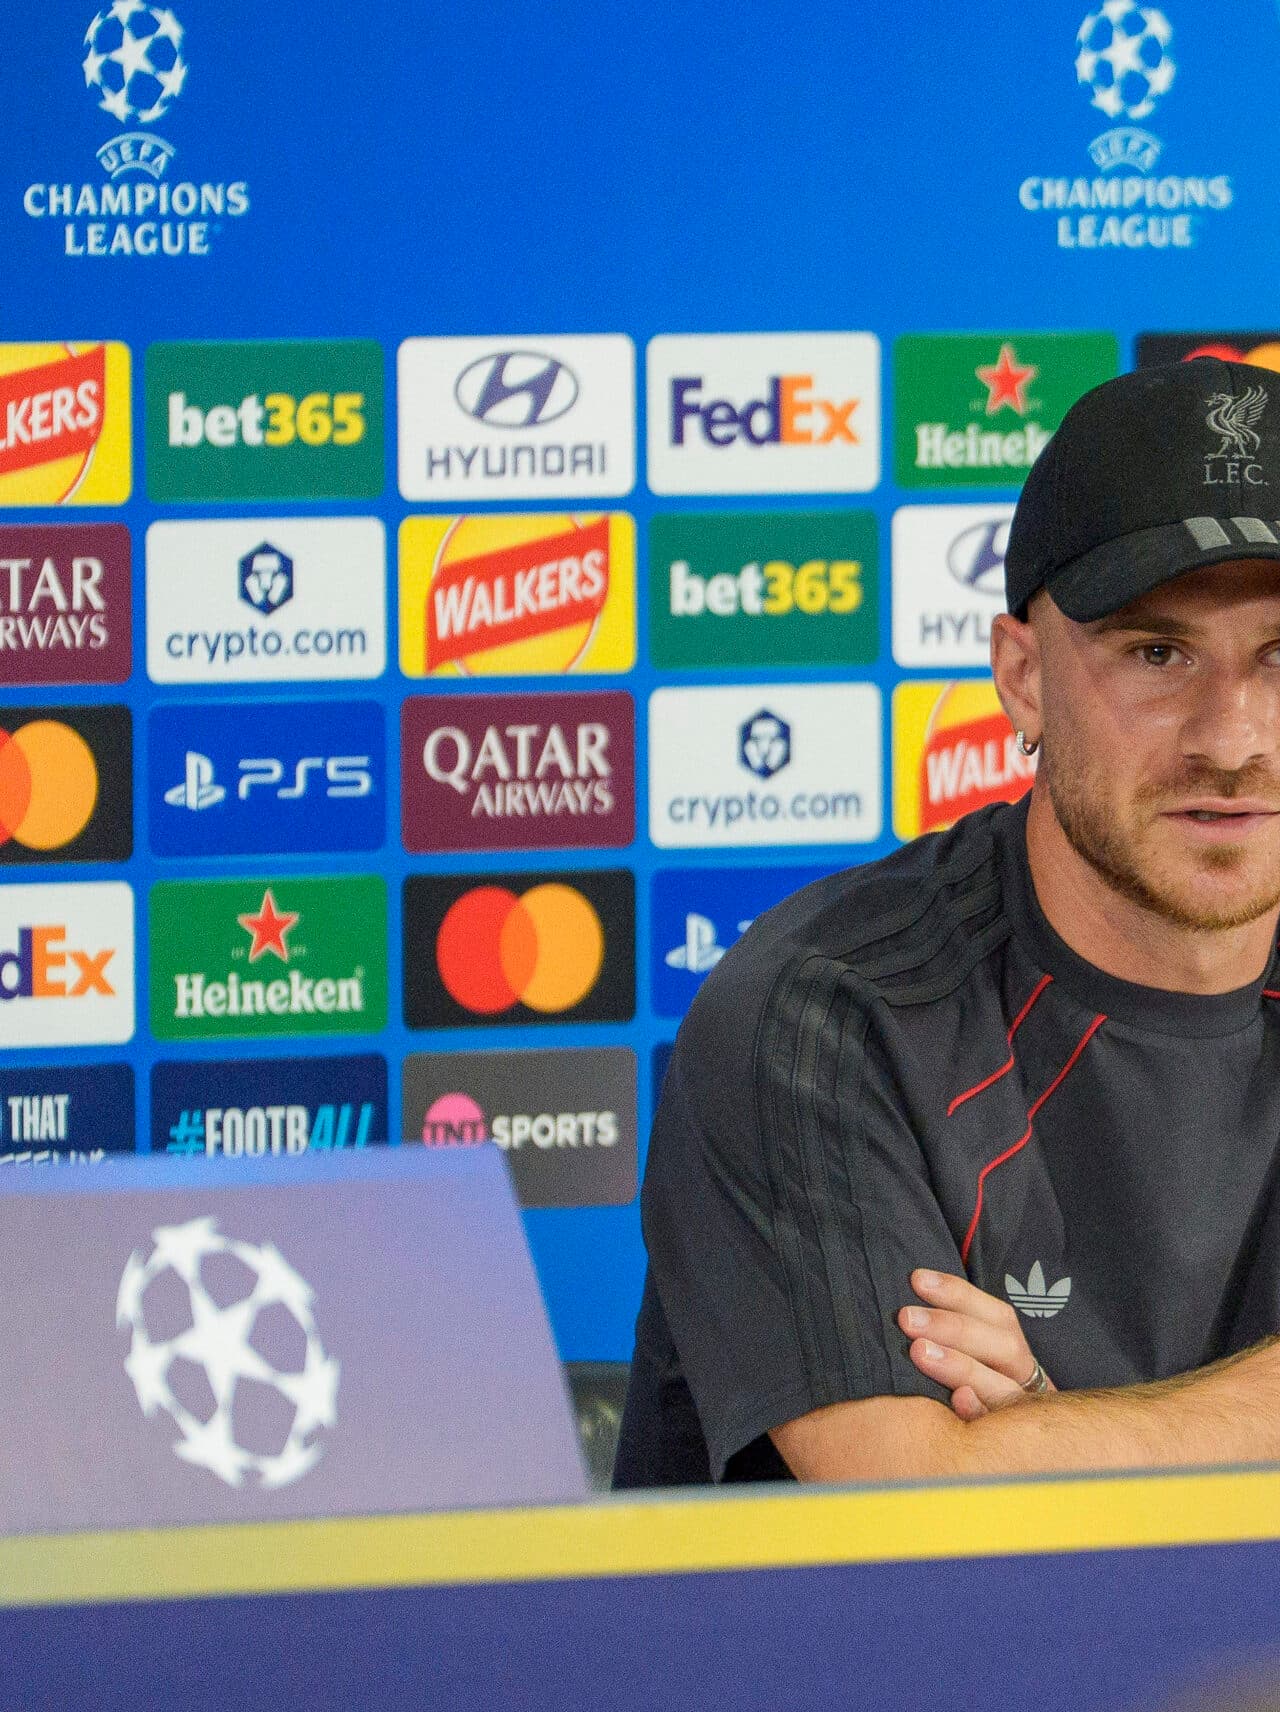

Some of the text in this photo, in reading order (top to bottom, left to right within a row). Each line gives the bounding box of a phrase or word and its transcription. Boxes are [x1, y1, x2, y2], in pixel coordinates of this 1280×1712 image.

[100, 138, 167, 174] UEFA
[23, 182, 250, 217] CHAMPIONS
[1018, 176, 1233, 211] CHAMPIONS
[64, 222, 208, 256] LEAGUE
[1057, 214, 1192, 248] LEAGUE
[168, 391, 365, 447] bet365
[670, 374, 861, 446] FedEx
[427, 442, 608, 479] HYUNDAI
[433, 548, 605, 641] WALKERS
[670, 559, 862, 616] bet365
[166, 625, 367, 665] crypto.com
[237, 755, 372, 799] PS5
[423, 723, 612, 794] QATAR
[471, 780, 614, 817] AIRWAYS
[668, 791, 863, 830] crypto.com
[175, 971, 364, 1018] Heineken
[10, 1095, 68, 1142] THAT
[492, 1110, 618, 1149] SPORTS
